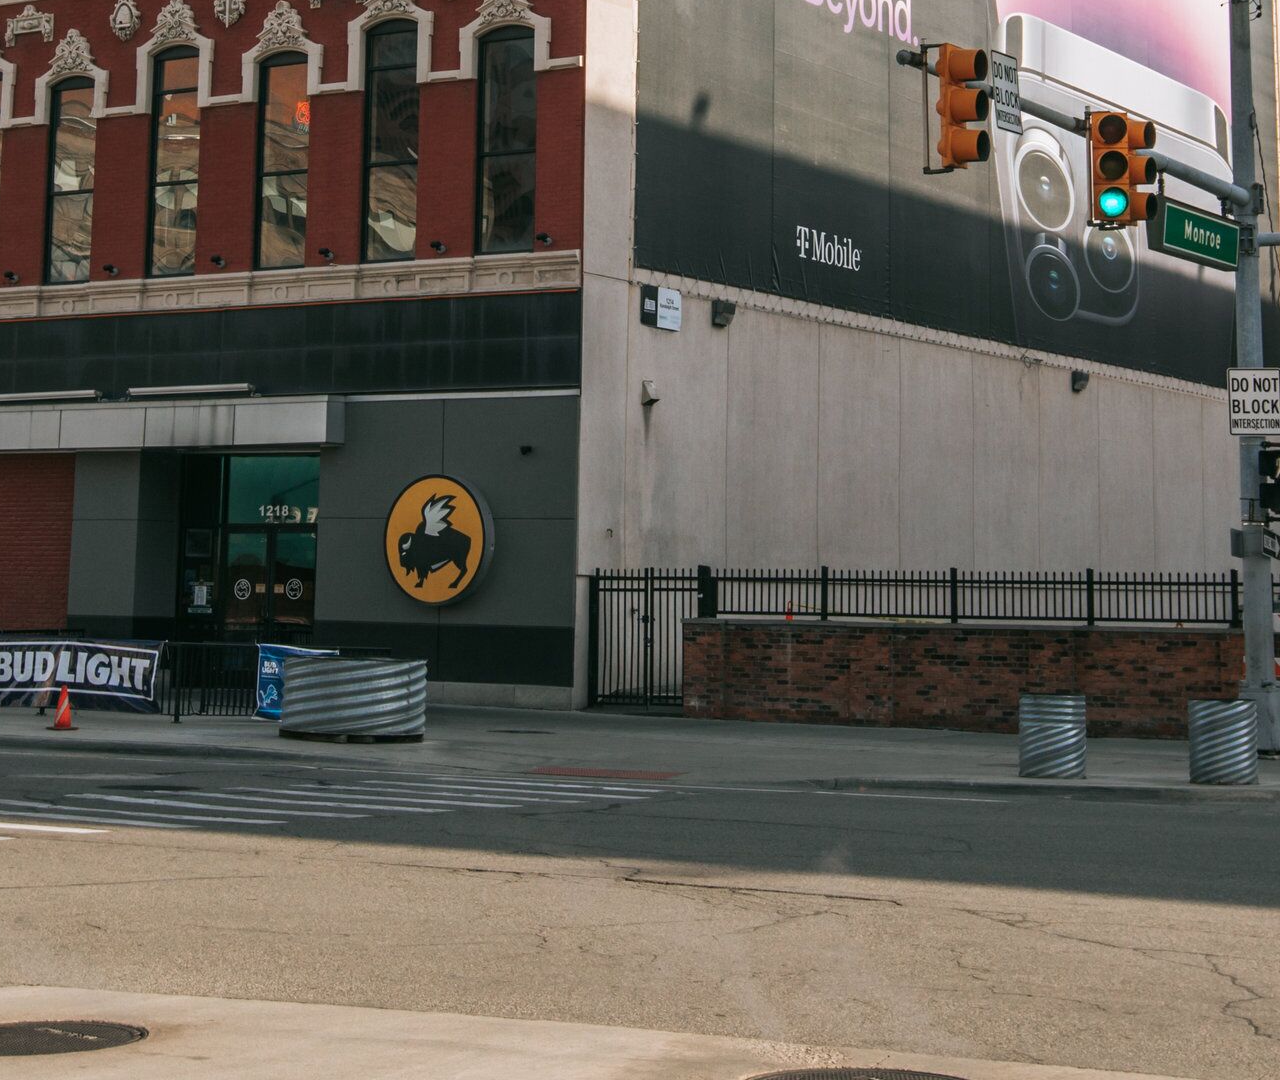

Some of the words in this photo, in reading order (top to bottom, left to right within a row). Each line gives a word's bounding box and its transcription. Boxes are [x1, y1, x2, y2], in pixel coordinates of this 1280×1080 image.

[993, 61, 1003, 80] DO
[1004, 65, 1017, 84] NOT
[995, 86, 1019, 110] BLOCK
[1184, 219, 1221, 250] Monroe
[1231, 377, 1249, 392] DO
[1253, 377, 1279, 392] NOT
[1232, 399, 1279, 414] BLOCK
[1231, 418, 1280, 429] INTERSECTION
[259, 505, 289, 517] 1218
[55, 651, 150, 691] LIGHT
